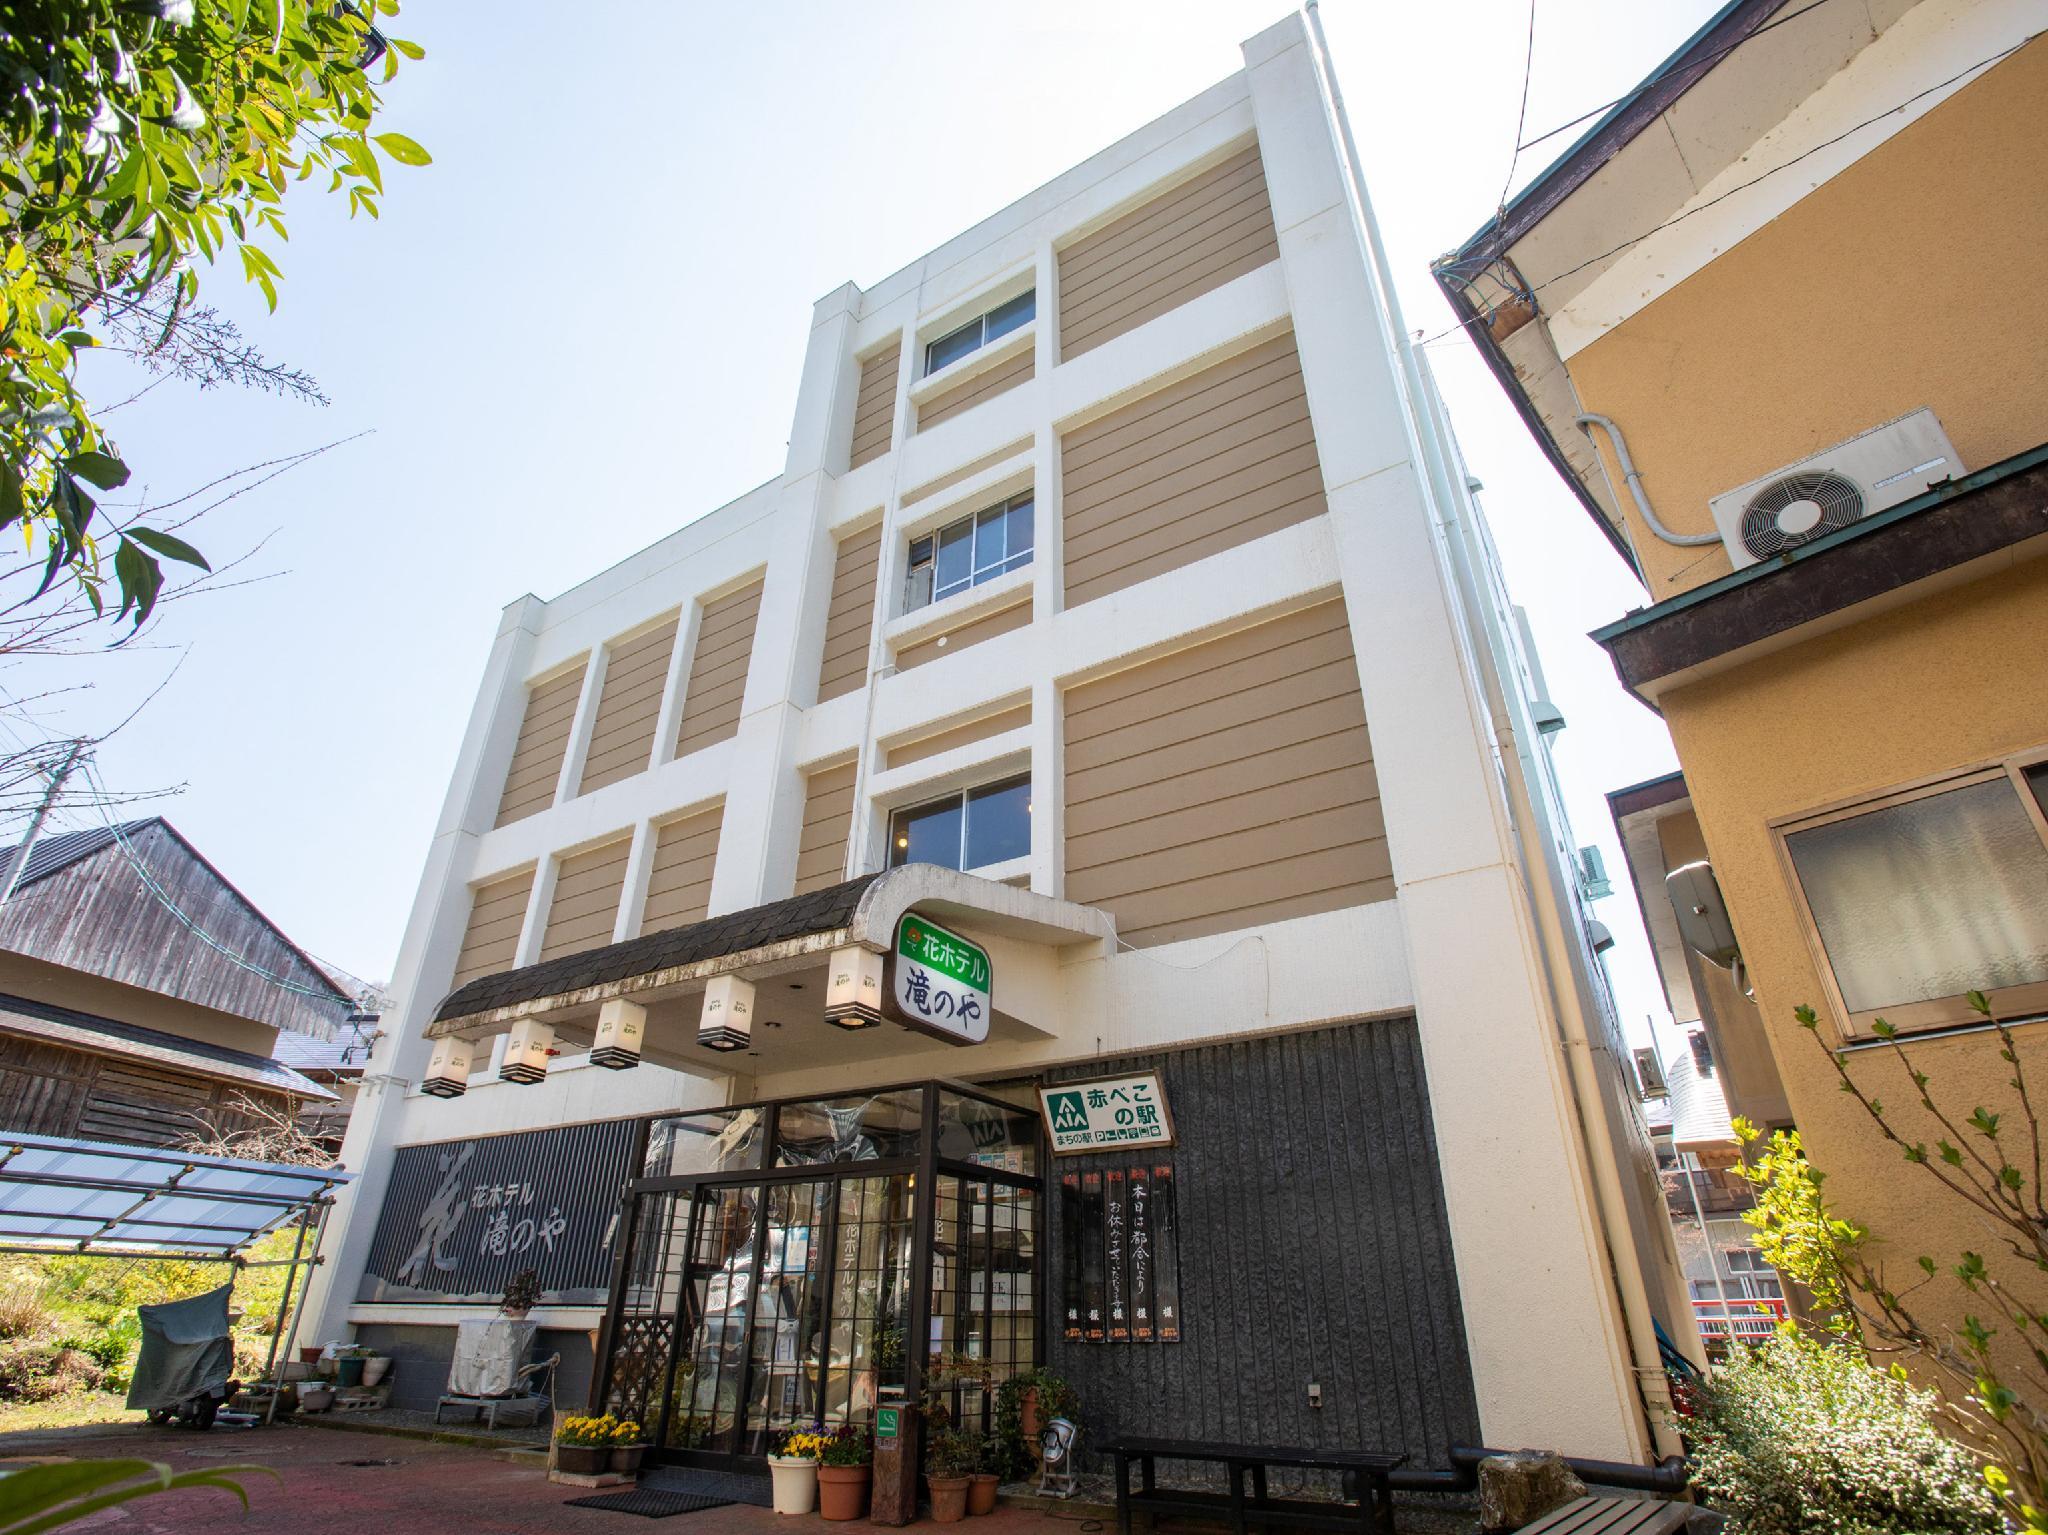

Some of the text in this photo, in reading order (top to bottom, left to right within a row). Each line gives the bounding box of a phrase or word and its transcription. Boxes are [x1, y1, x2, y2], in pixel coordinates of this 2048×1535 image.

[922, 933, 985, 982] 花ホテル
[904, 967, 981, 1030] 滝のや
[1087, 1084, 1152, 1109] 赤べこ
[1115, 1104, 1159, 1125] の駅
[1056, 1133, 1093, 1145] まちの駅
[472, 1182, 535, 1208] 花ホテル
[481, 1208, 566, 1256] 滝のや
